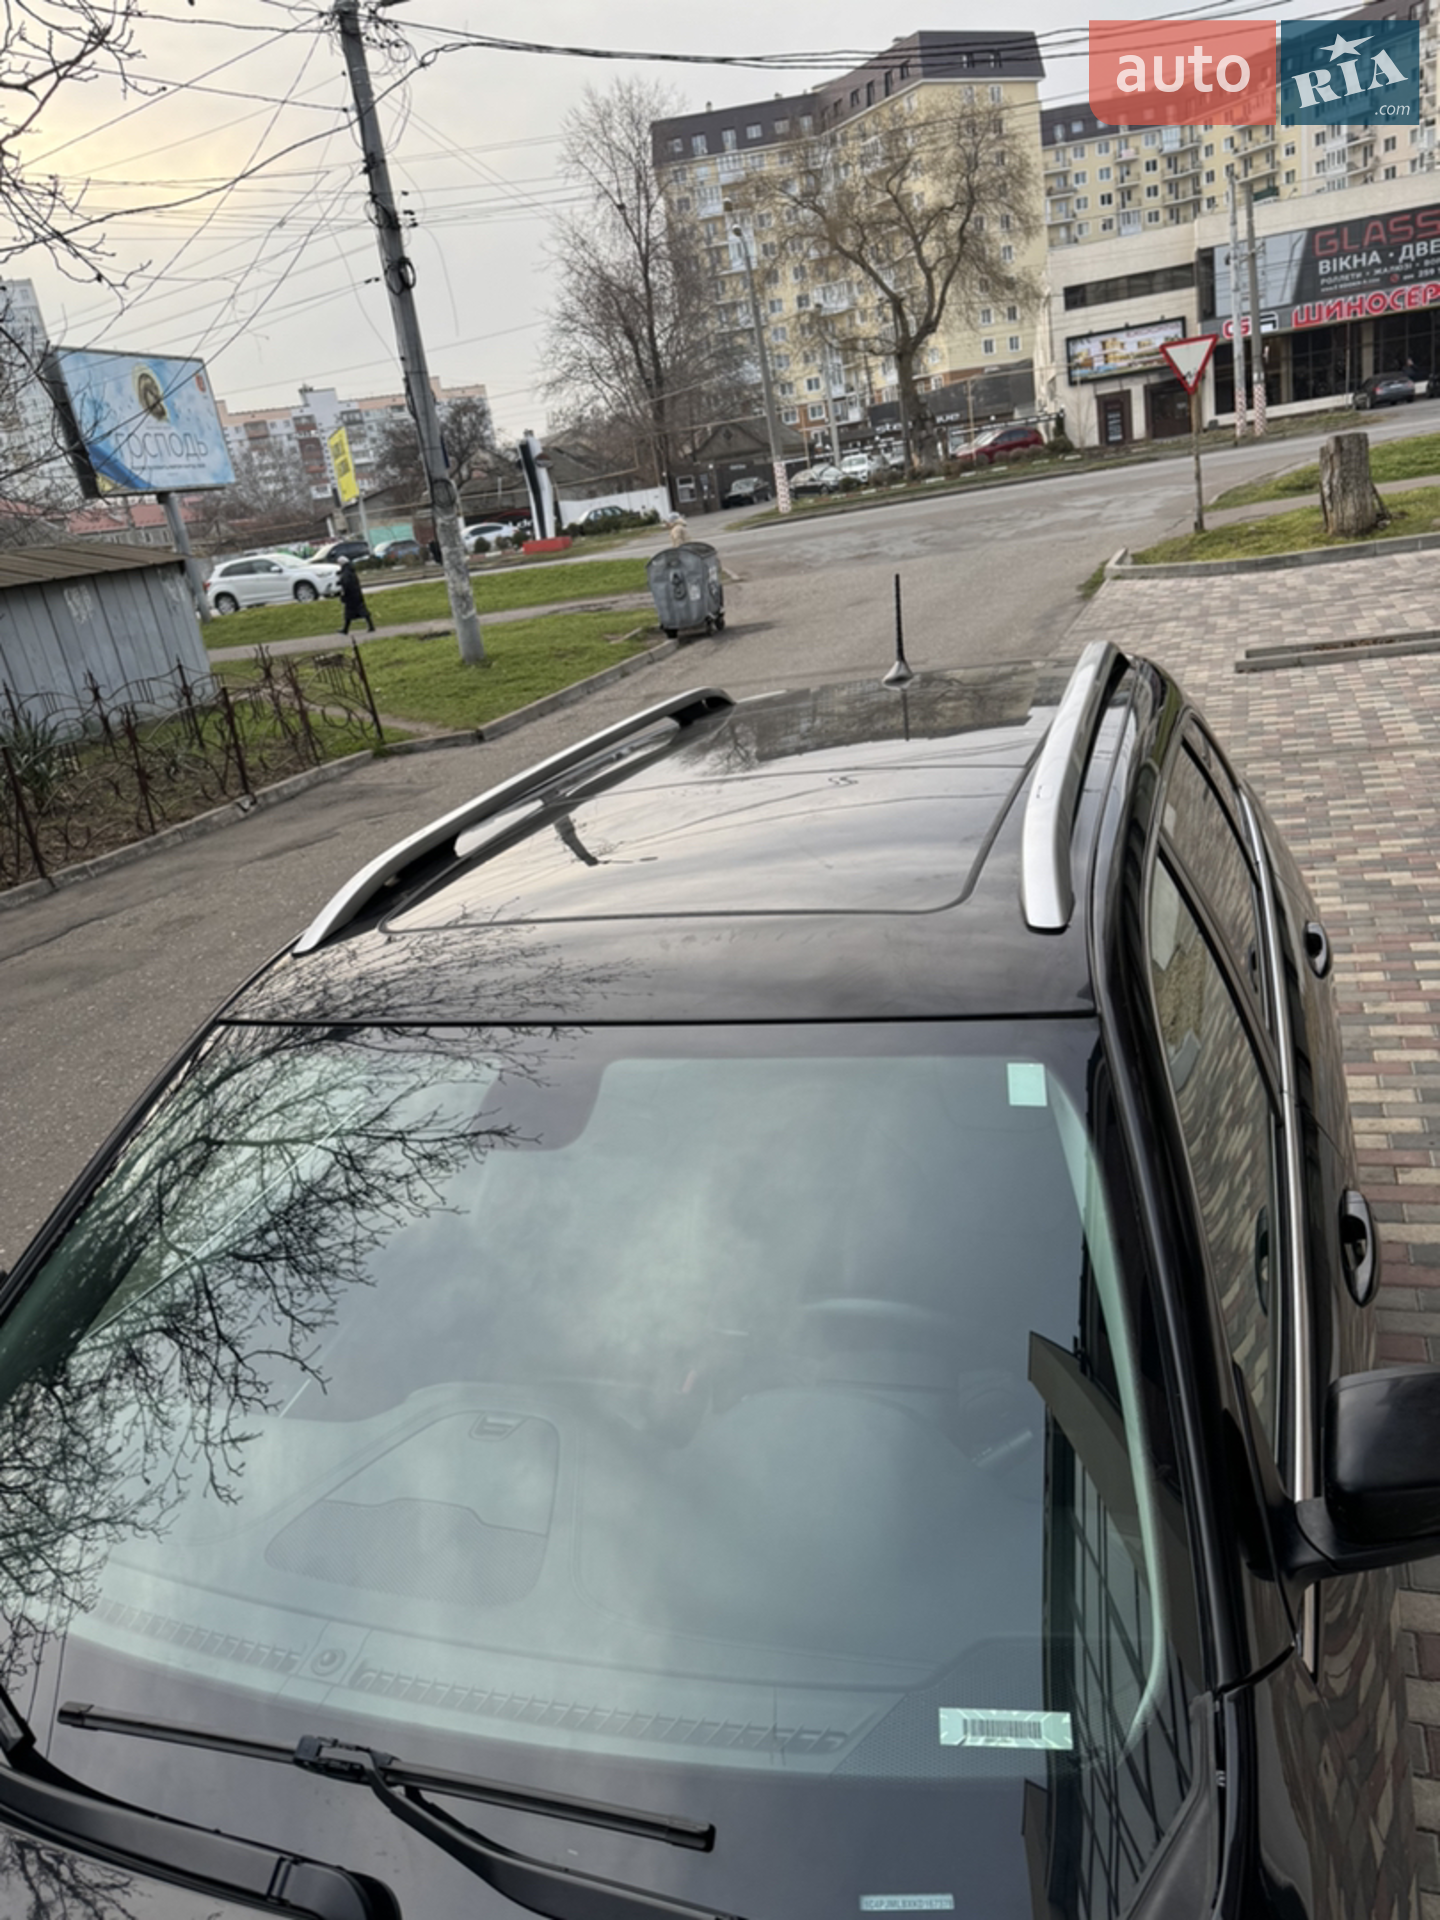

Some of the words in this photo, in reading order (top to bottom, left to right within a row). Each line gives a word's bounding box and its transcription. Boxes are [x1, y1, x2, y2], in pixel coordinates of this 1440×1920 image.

[1314, 209, 1440, 257] GLASS
[1318, 250, 1382, 276] ВІКНА
[114, 433, 209, 461] ГОСПОДЬ
